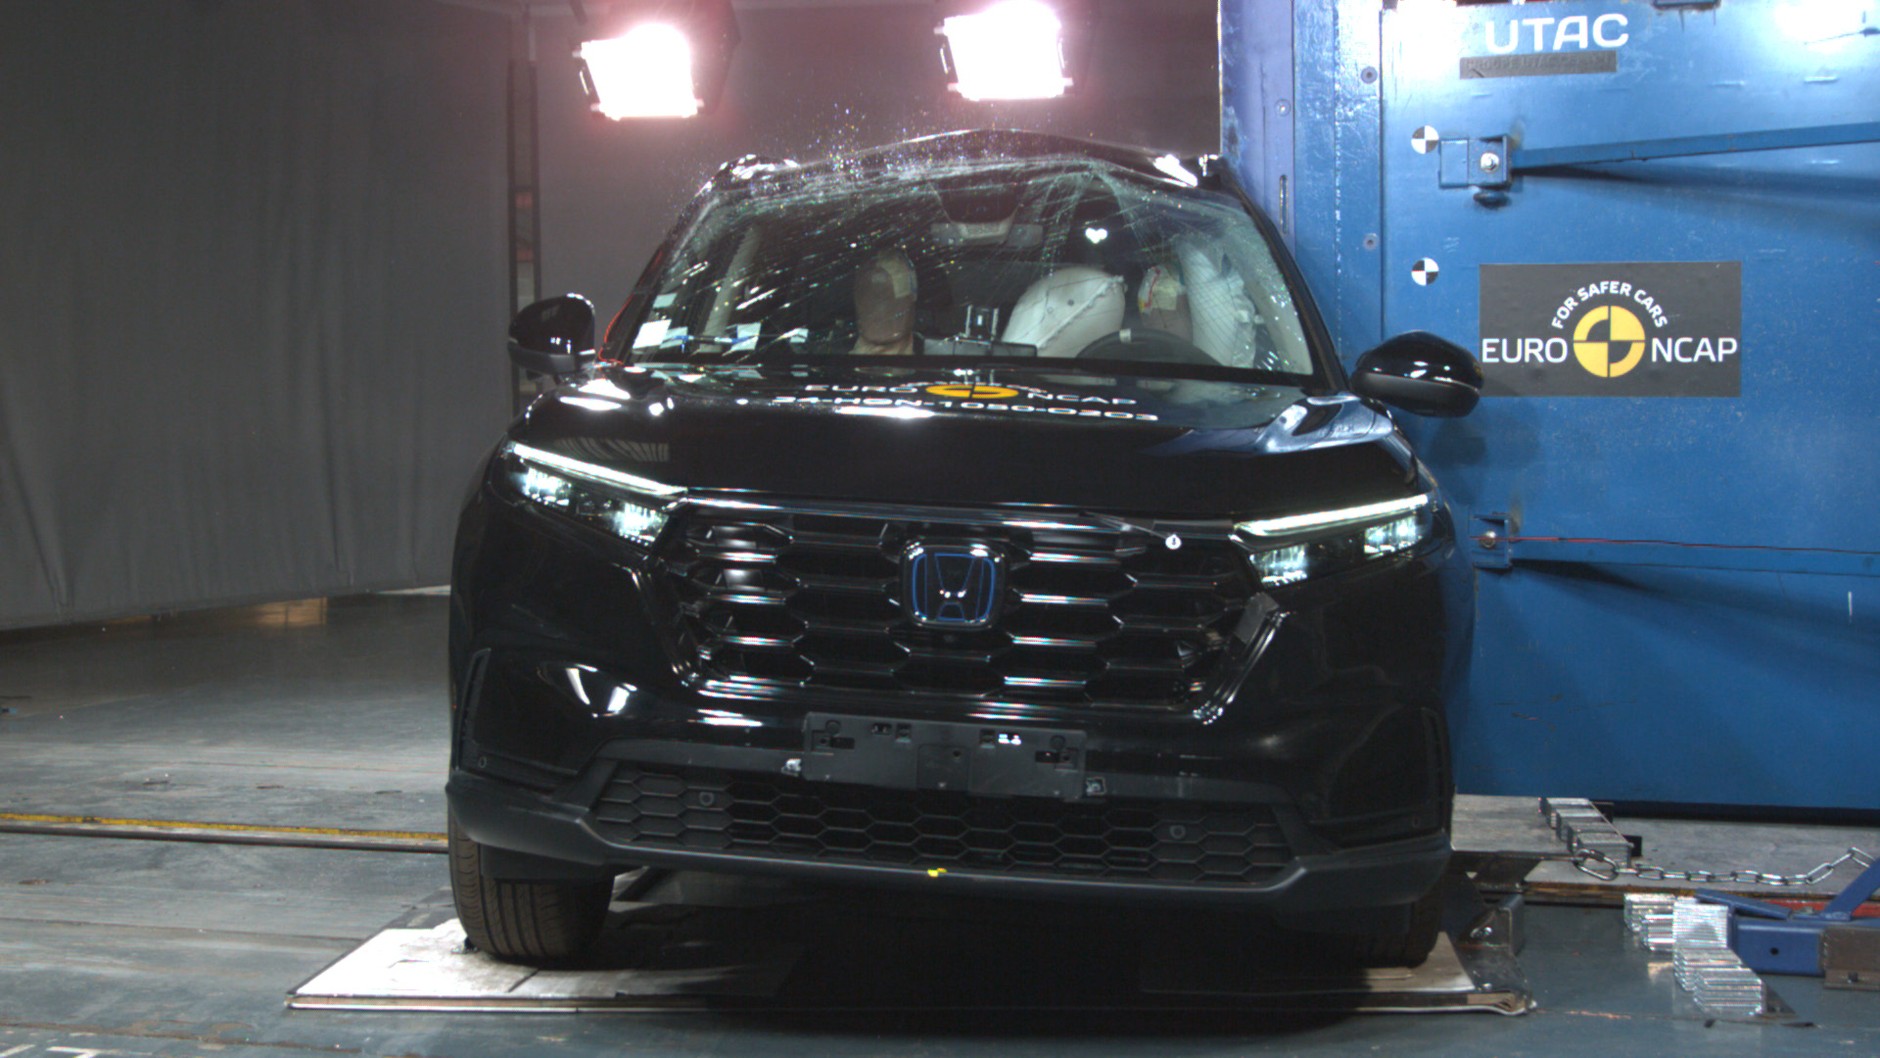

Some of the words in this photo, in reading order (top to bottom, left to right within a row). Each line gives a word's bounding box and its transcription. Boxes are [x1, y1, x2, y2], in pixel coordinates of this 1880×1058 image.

[1486, 13, 1630, 54] UTAC
[1551, 296, 1579, 330] FOR
[1577, 280, 1633, 303] SAFER
[1633, 288, 1669, 329] CARS
[1481, 337, 1568, 363] EURO
[1651, 337, 1738, 363] NCAP
[804, 384, 918, 394] EURO
